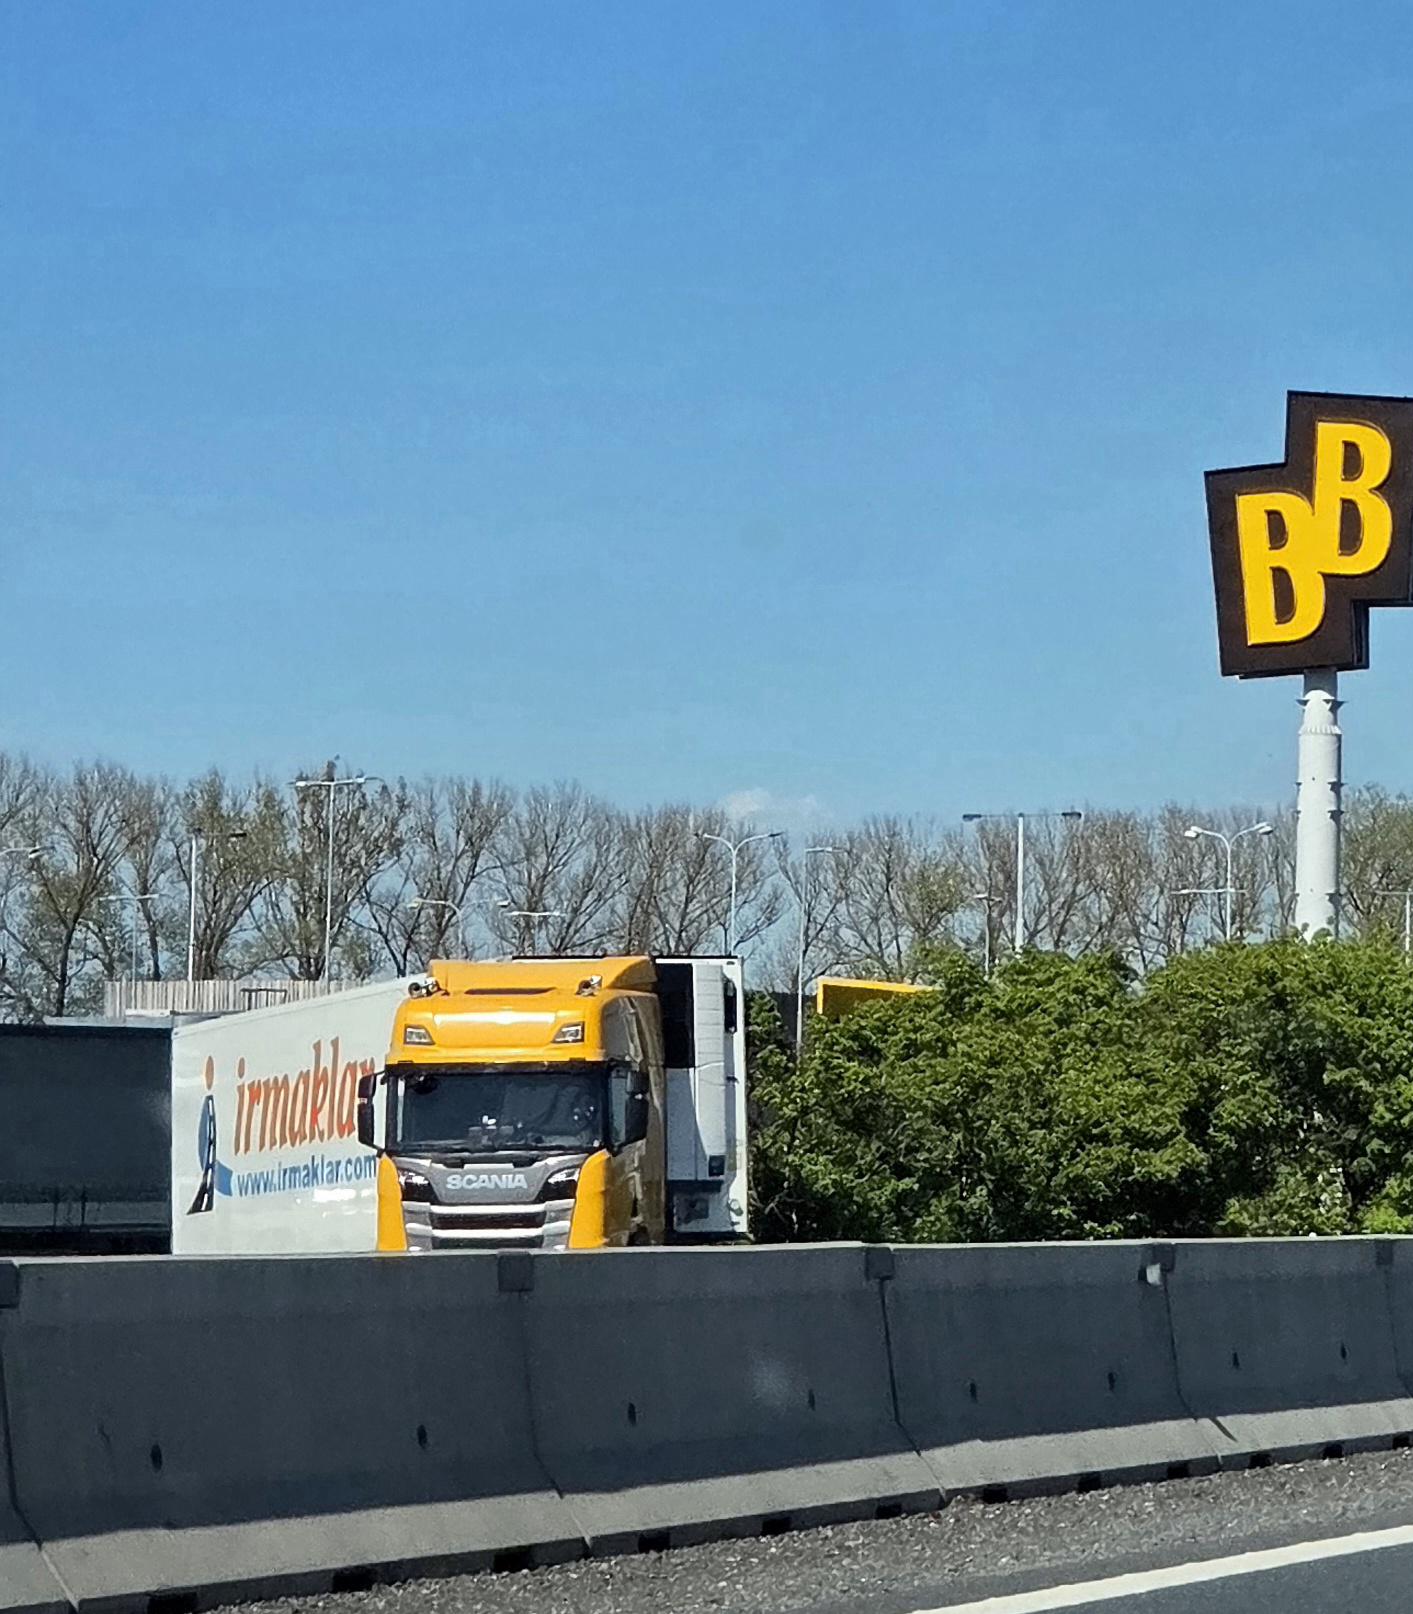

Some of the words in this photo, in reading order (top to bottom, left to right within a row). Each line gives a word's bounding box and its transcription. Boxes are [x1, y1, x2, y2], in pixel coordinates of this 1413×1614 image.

[234, 1036, 376, 1156] irmakla
[236, 1154, 377, 1198] www.irmaklar.com
[446, 1174, 528, 1190] SCANIA
